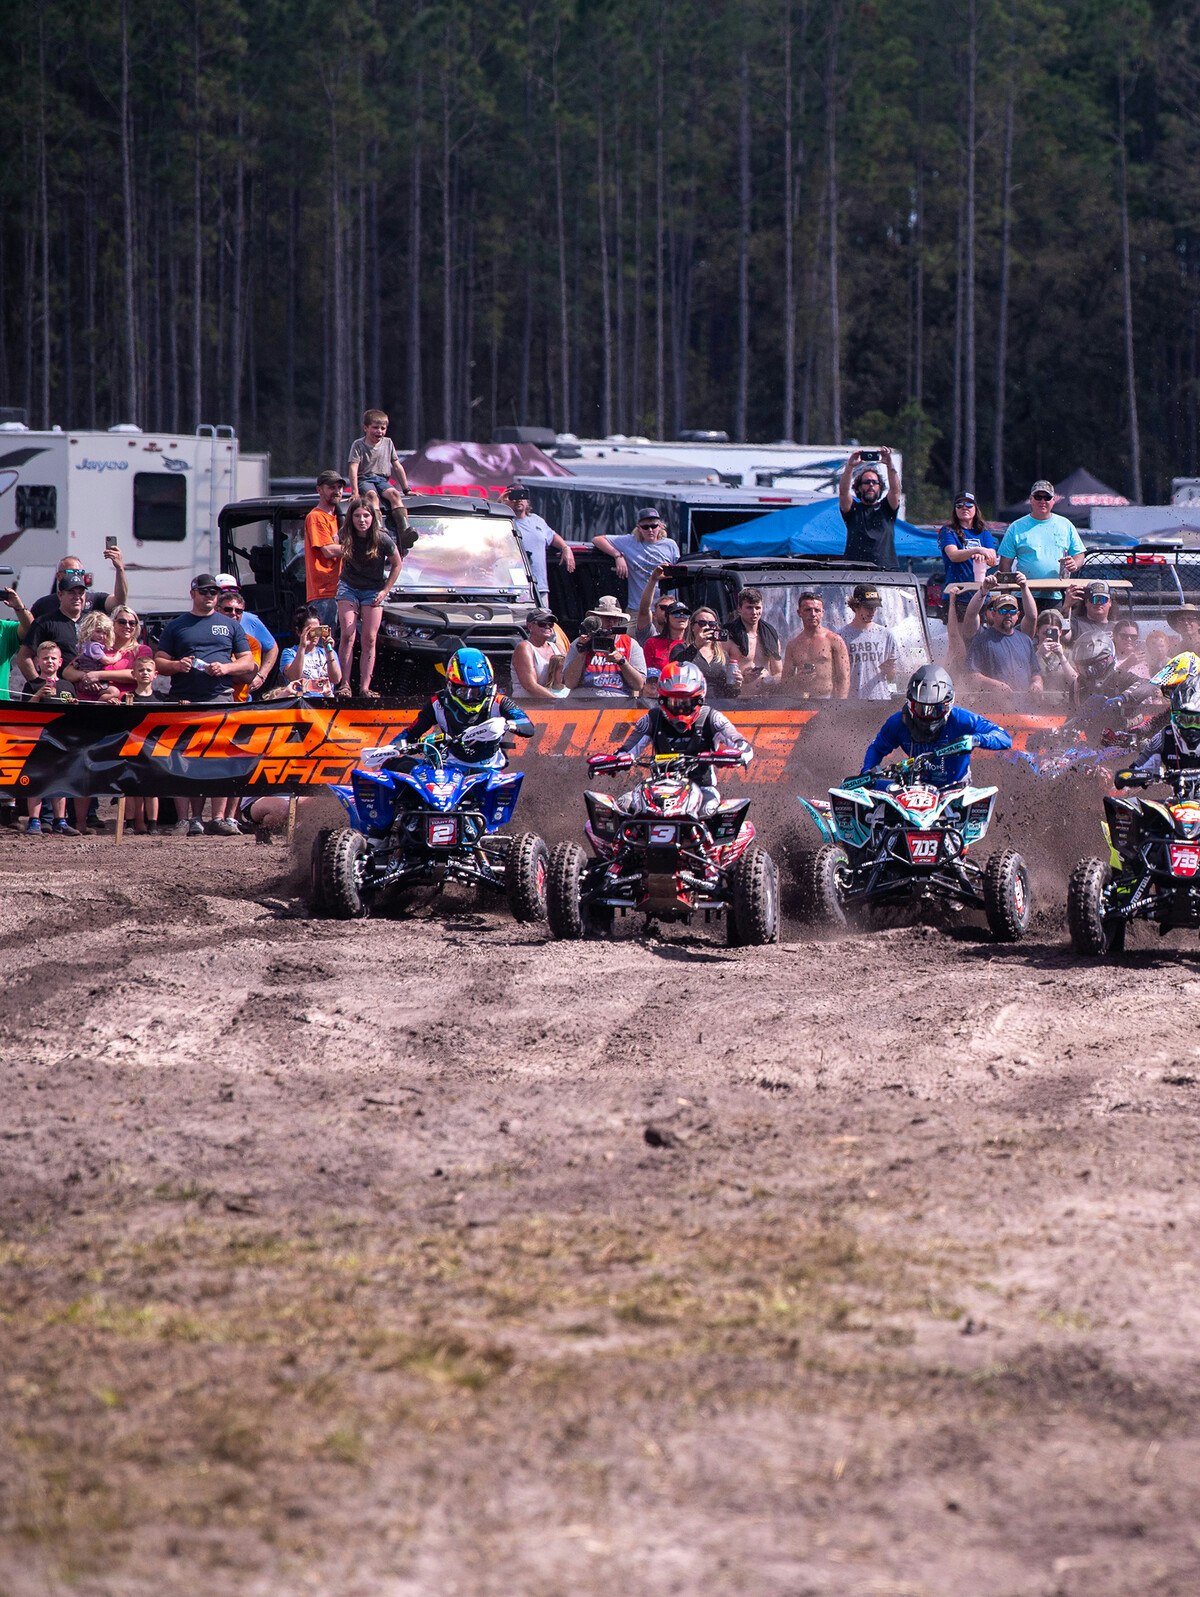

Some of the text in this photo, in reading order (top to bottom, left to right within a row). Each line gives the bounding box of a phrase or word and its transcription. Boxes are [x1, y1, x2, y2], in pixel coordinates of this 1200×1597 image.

[76, 458, 128, 473] Jayco
[849, 641, 880, 653] BABY
[119, 708, 422, 757] MOOS
[512, 709, 819, 757] MOE
[248, 758, 368, 786] RACI
[432, 824, 454, 843] 2
[651, 824, 675, 843] 3
[912, 840, 938, 857] 703
[1173, 853, 1198, 869] 733
